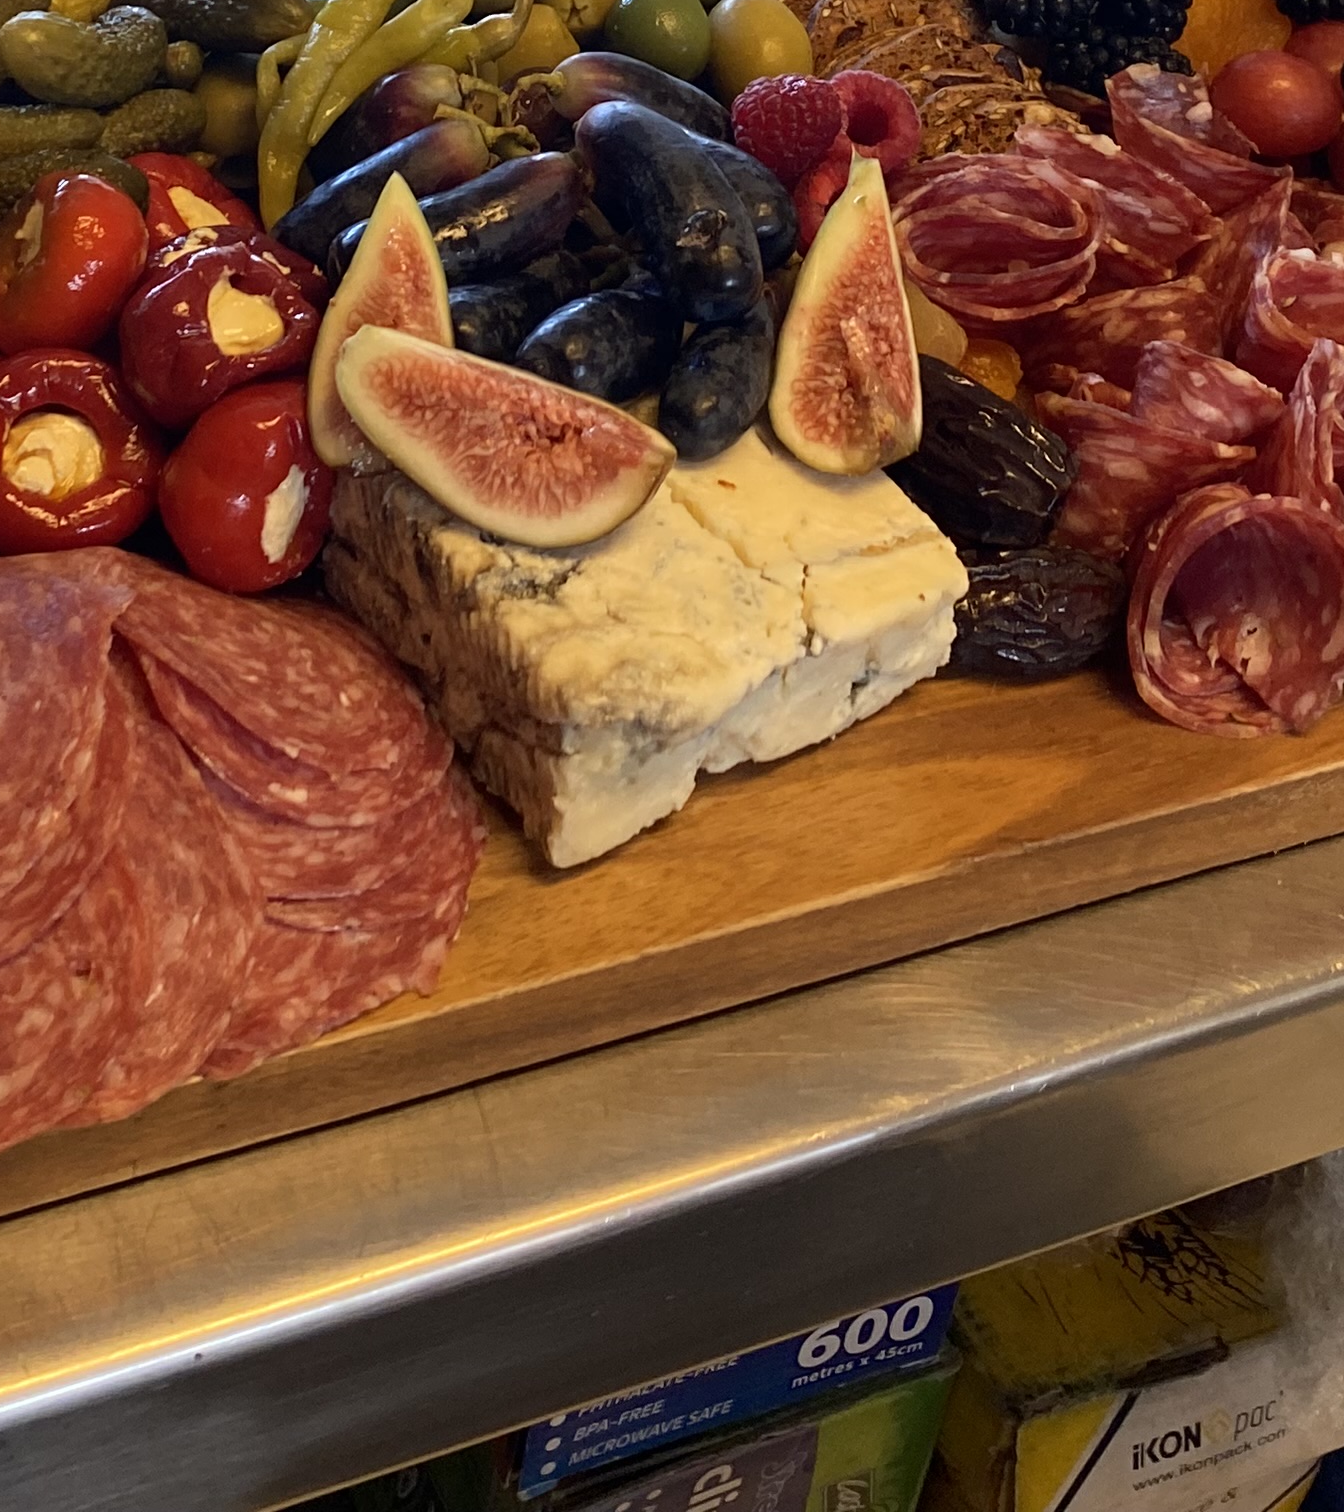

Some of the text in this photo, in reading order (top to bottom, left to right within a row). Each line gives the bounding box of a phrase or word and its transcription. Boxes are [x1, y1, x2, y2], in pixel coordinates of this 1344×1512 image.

[797, 1295, 934, 1368] 600
[791, 1360, 854, 1389] metres
[874, 1341, 924, 1361] 45cm
[568, 1399, 735, 1467] MICROWAVE SAFE
[573, 1399, 666, 1441] BPA-FREE
